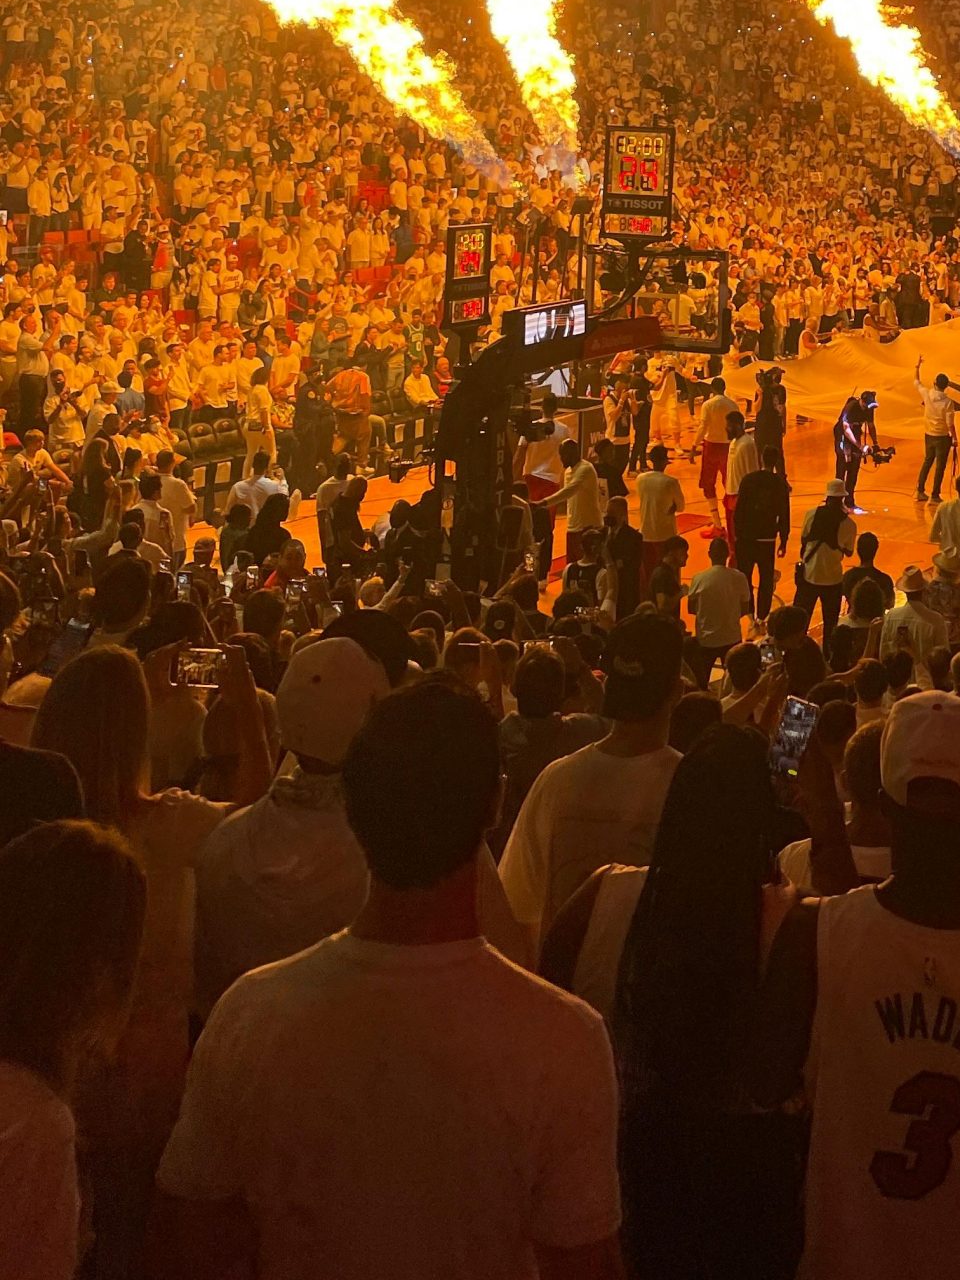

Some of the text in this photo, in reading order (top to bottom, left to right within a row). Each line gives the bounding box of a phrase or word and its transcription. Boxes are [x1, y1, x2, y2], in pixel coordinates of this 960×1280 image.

[618, 135, 663, 156] 12:00
[619, 156, 658, 192] 24
[622, 199, 664, 210] TISSOT
